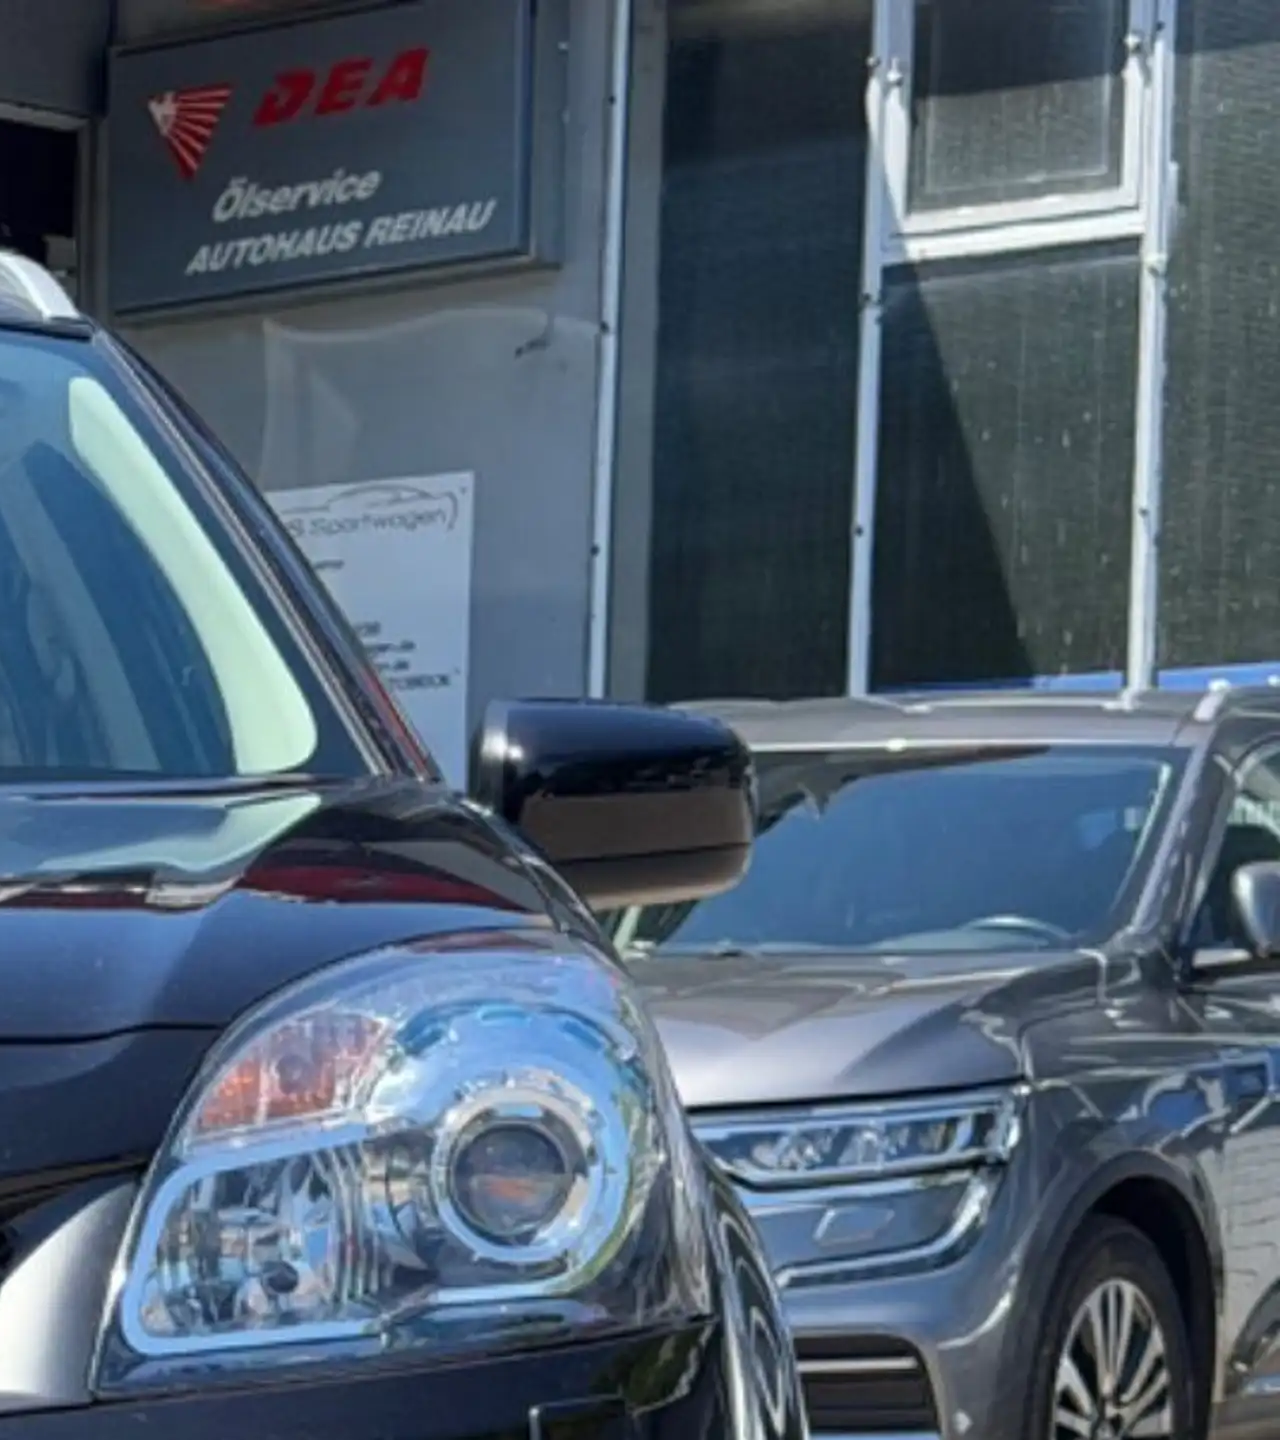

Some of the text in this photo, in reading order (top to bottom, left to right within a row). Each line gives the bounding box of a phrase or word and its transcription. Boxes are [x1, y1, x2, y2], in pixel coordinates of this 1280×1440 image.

[253, 45, 430, 127] DEA
[211, 168, 383, 223] Ölservice
[185, 199, 498, 276] AUTOHAUS REINAU
